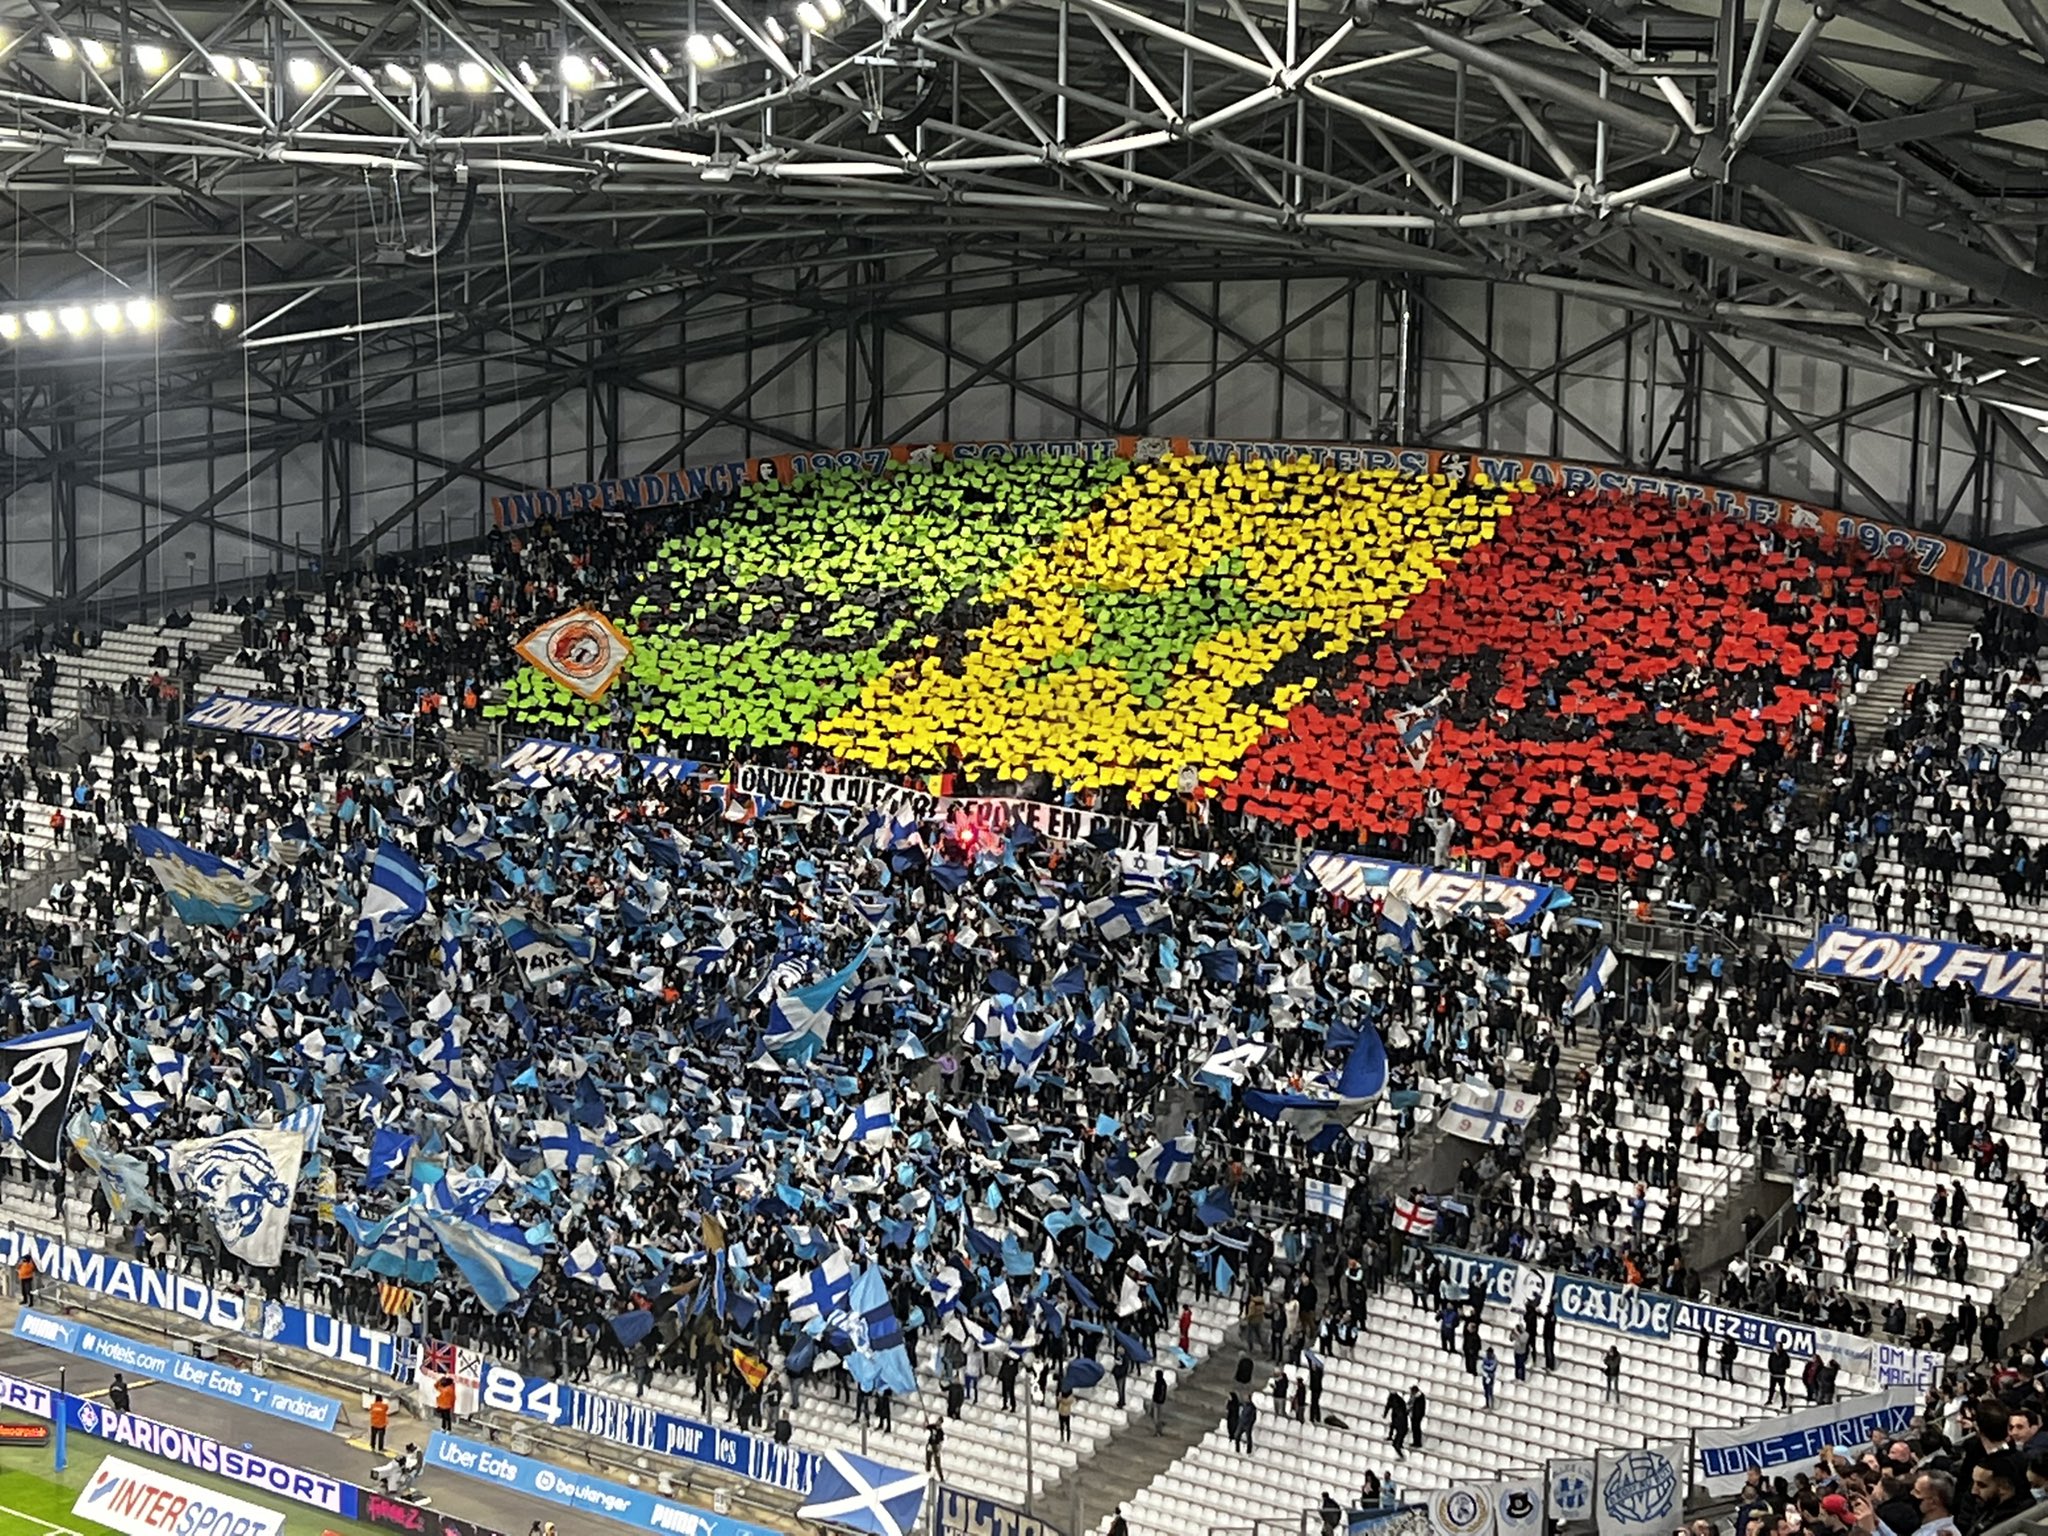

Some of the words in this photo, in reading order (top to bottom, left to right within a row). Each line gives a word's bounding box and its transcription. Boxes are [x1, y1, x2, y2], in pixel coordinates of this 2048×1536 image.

[500, 462, 748, 527] INDEPENDANCE
[791, 448, 891, 476] 1987
[953, 439, 1118, 462] SOUTH
[1188, 440, 1430, 474] WINNERS
[1479, 458, 1781, 524] MARSEILLE
[1837, 517, 1946, 575] 1987
[741, 767, 824, 805] OLIVIER
[1050, 809, 1081, 839] EN
[1803, 931, 1940, 984] FOR
[1562, 1283, 1673, 1334] GARDE
[1676, 1306, 1741, 1340] ALLEZ
[96, 1336, 167, 1374] Hotels.com
[1880, 1346, 1904, 1366] OM
[173, 1359, 209, 1387] Uber
[208, 1370, 244, 1397] Eats
[484, 1366, 562, 1424] 84
[270, 1391, 329, 1423] randstad
[571, 1390, 657, 1449] LIBERTE
[666, 1423, 703, 1455] pour
[715, 1429, 737, 1466] les
[101, 1409, 220, 1473] PARIONS
[226, 1452, 338, 1505] SPORT
[438, 1440, 478, 1469] Uber
[477, 1452, 518, 1482] Eats
[555, 1477, 632, 1513] boulanger
[650, 1503, 700, 1536] PUMA
